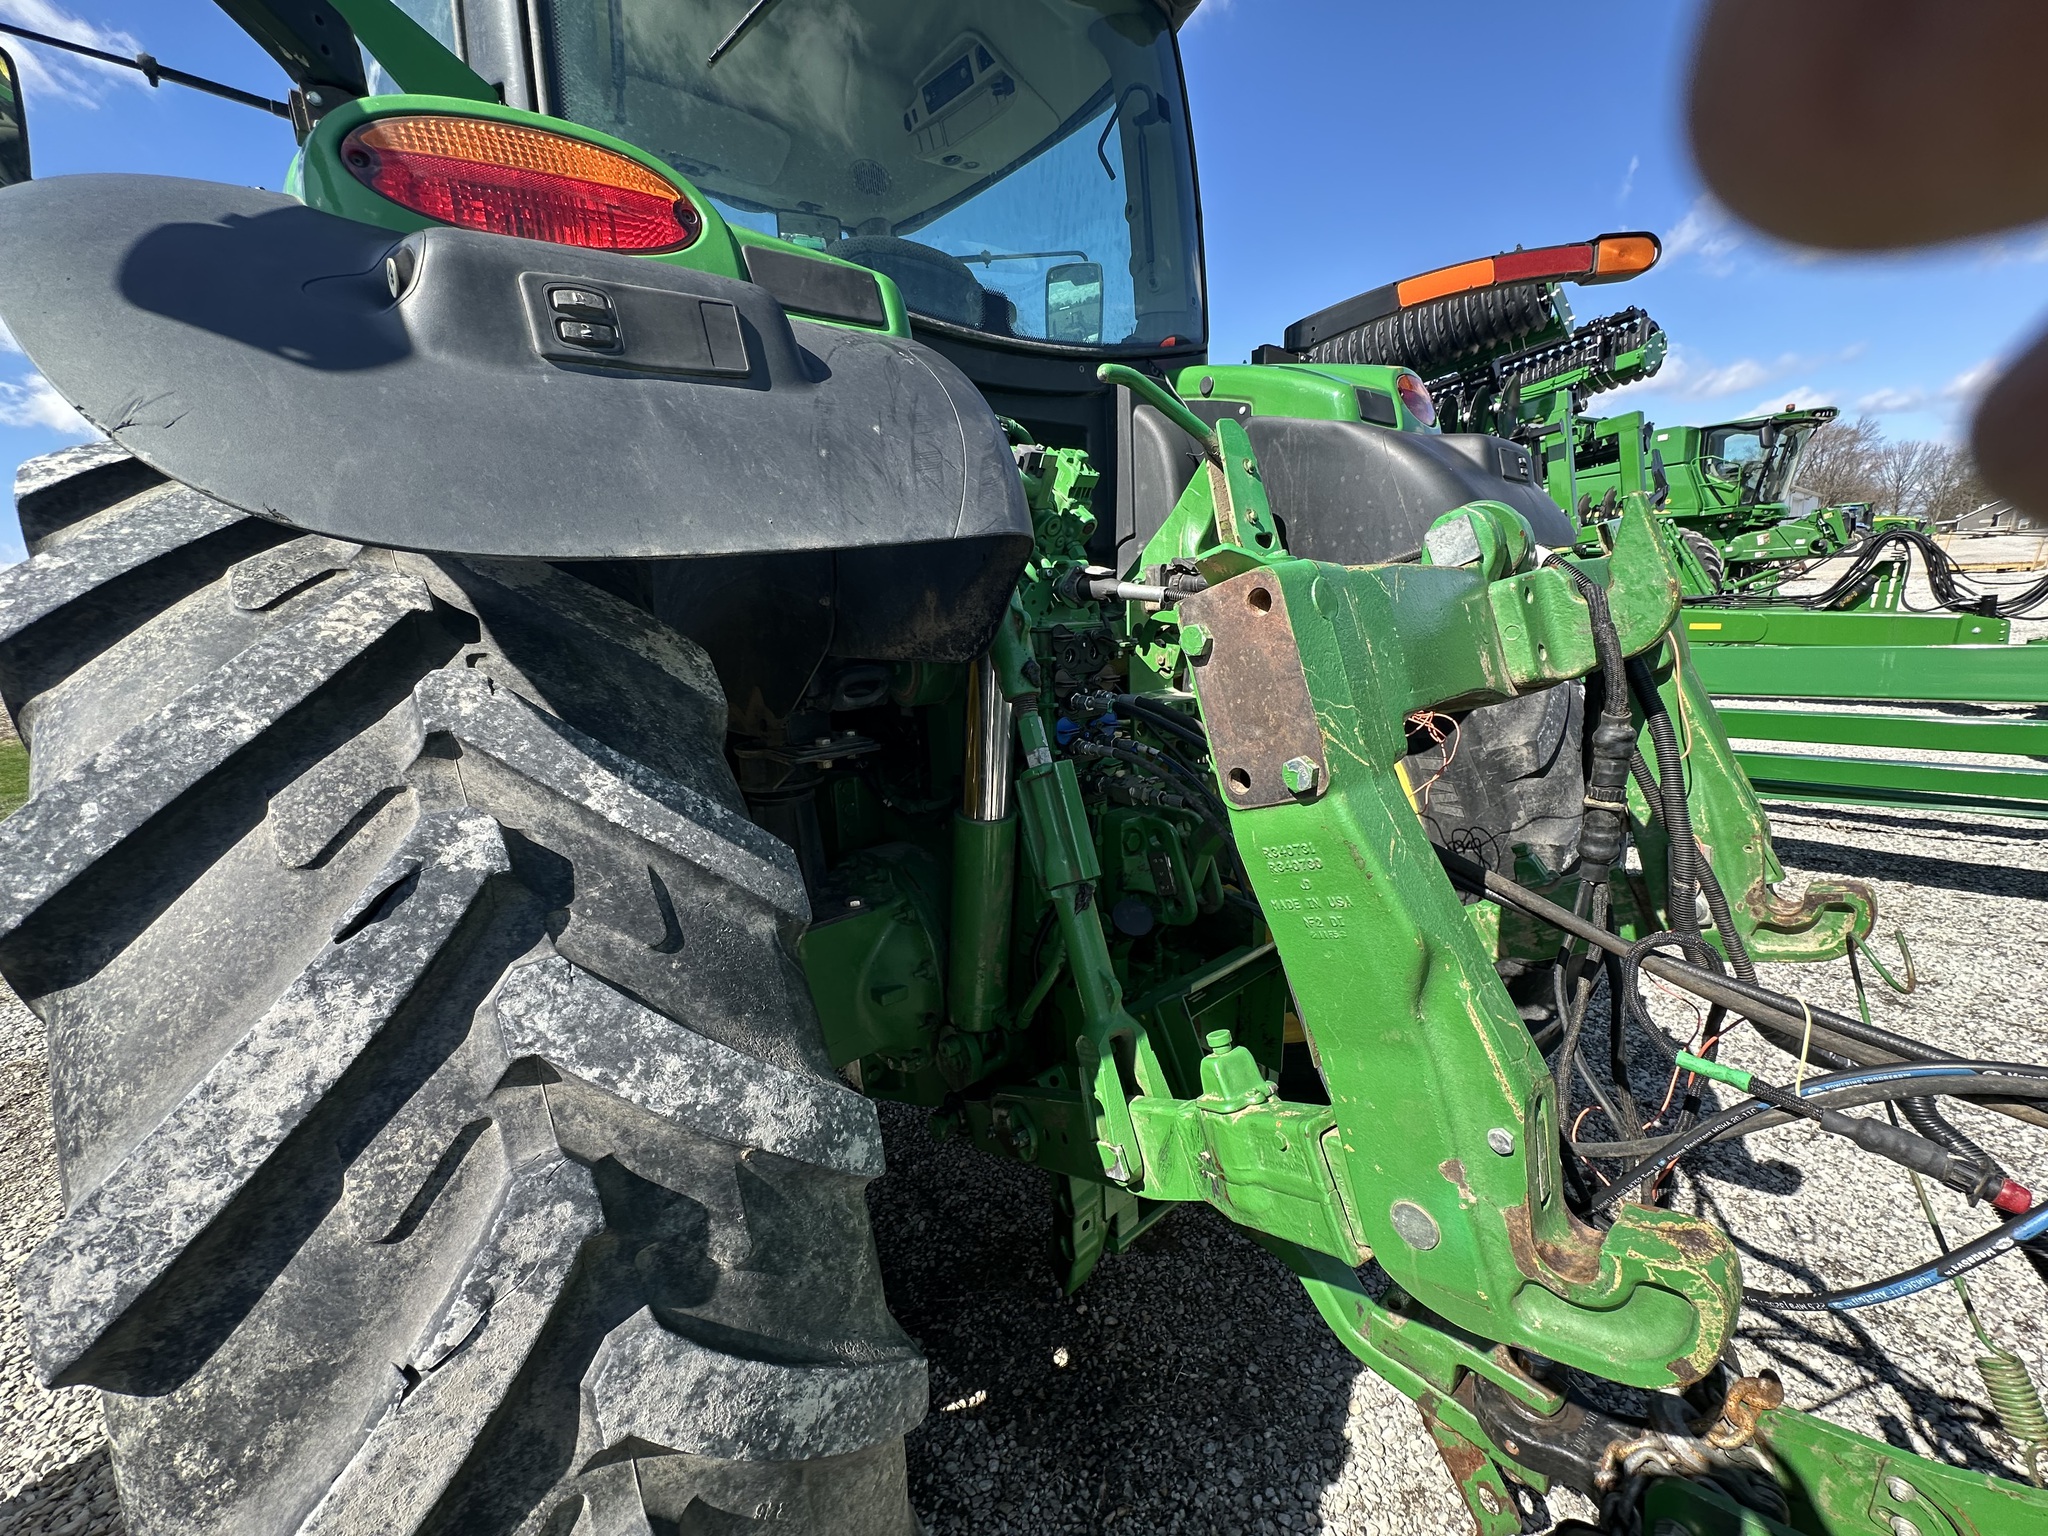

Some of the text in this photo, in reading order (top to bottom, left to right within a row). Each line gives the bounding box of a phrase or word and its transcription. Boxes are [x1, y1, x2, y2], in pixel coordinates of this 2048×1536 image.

[1270, 895, 1354, 911] MADE IN USA
[1824, 1080, 1863, 1091] POWERING
[1684, 1131, 1712, 1150] Resistant
[1711, 1120, 1732, 1134] MSHA
